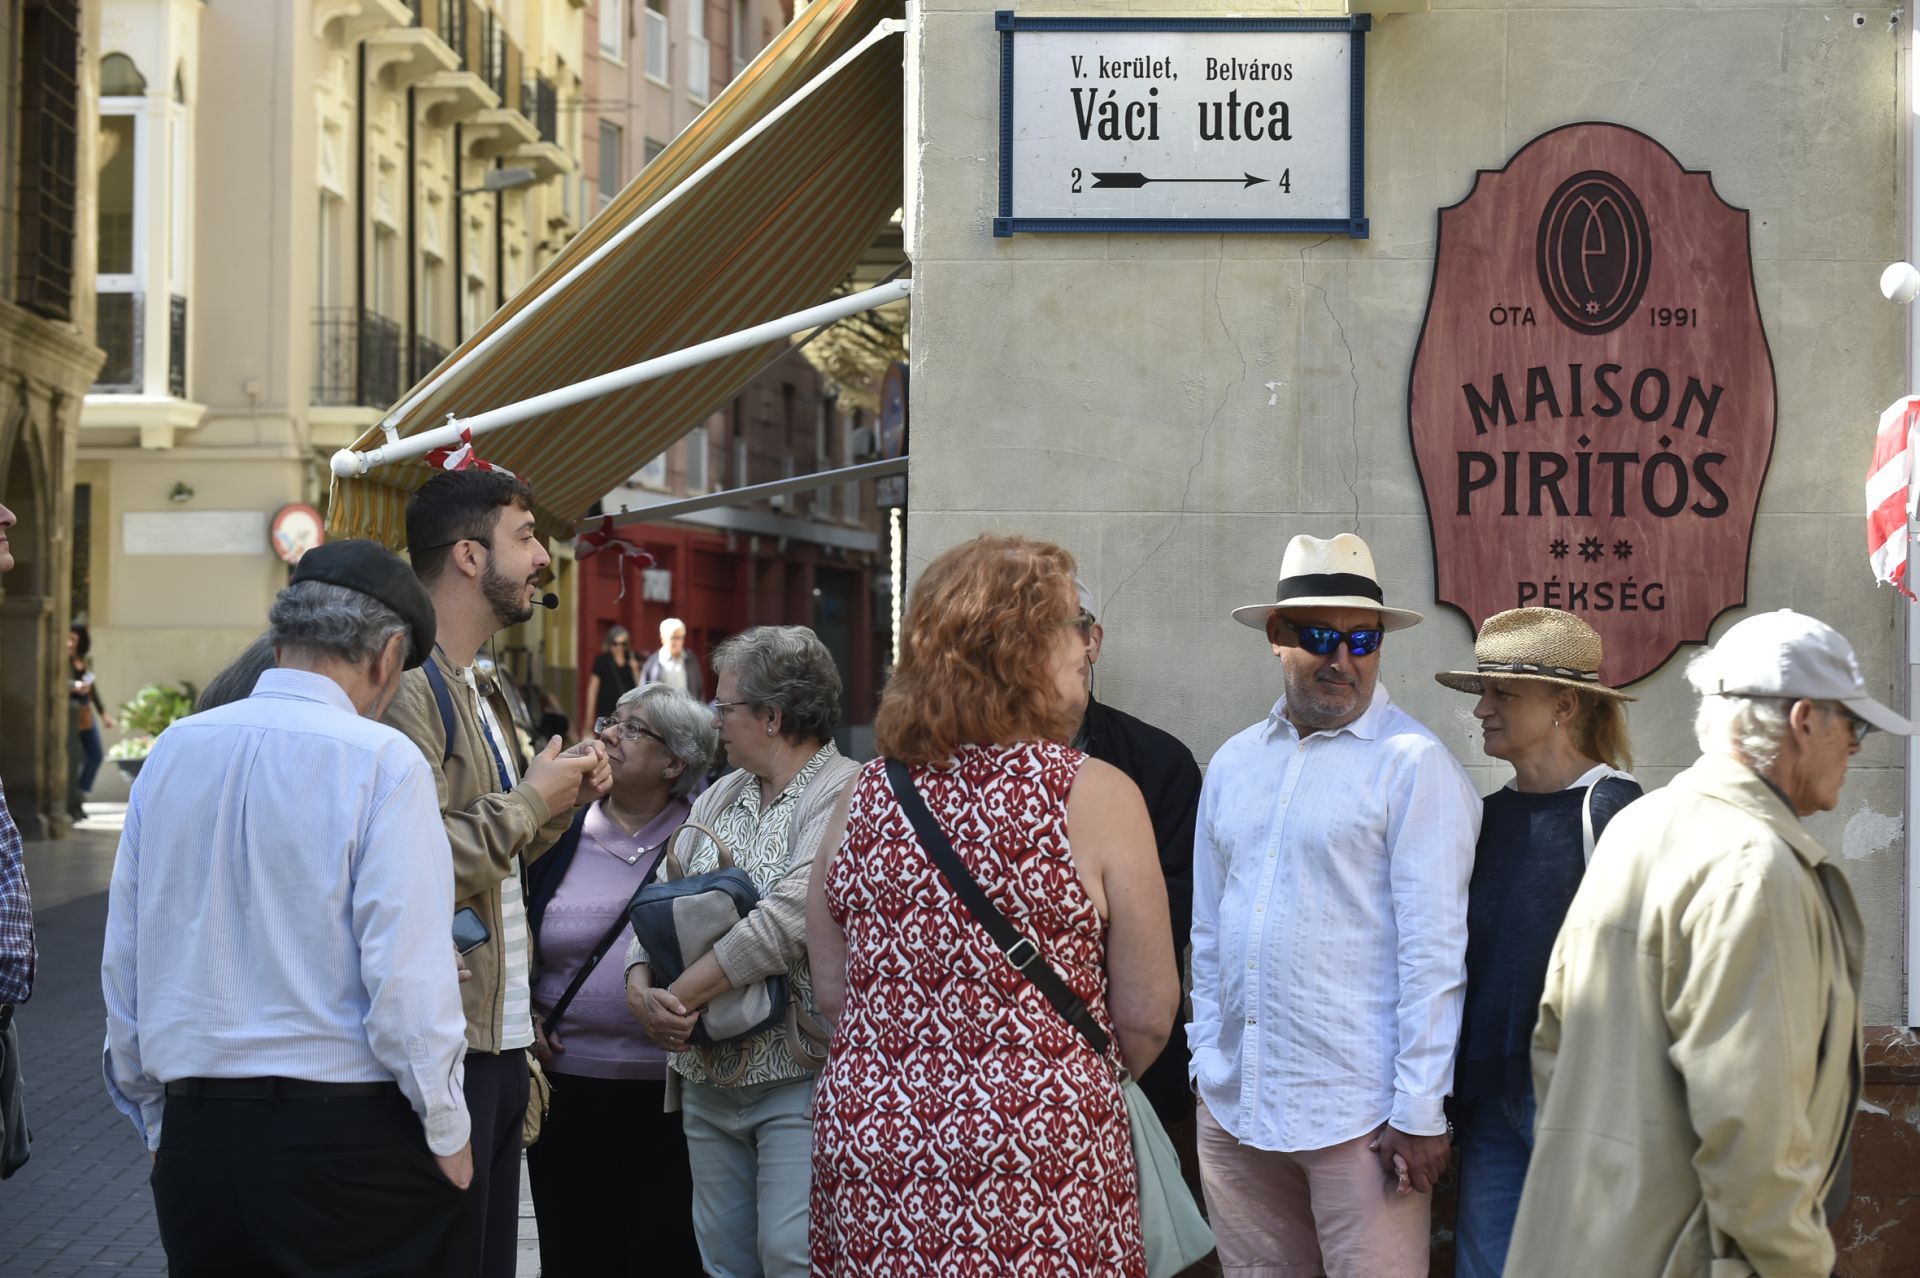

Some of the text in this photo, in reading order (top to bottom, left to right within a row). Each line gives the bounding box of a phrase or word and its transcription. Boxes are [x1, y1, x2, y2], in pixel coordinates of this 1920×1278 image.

[1070, 55, 1293, 81] V. kerület, Belváros
[1070, 87, 1293, 141] Váci utca
[1071, 167, 1291, 194] 2 4
[1650, 307, 1697, 328] 1991
[1461, 363, 1725, 438] MAISON
[1517, 575, 1666, 611] PÉKSÉG
